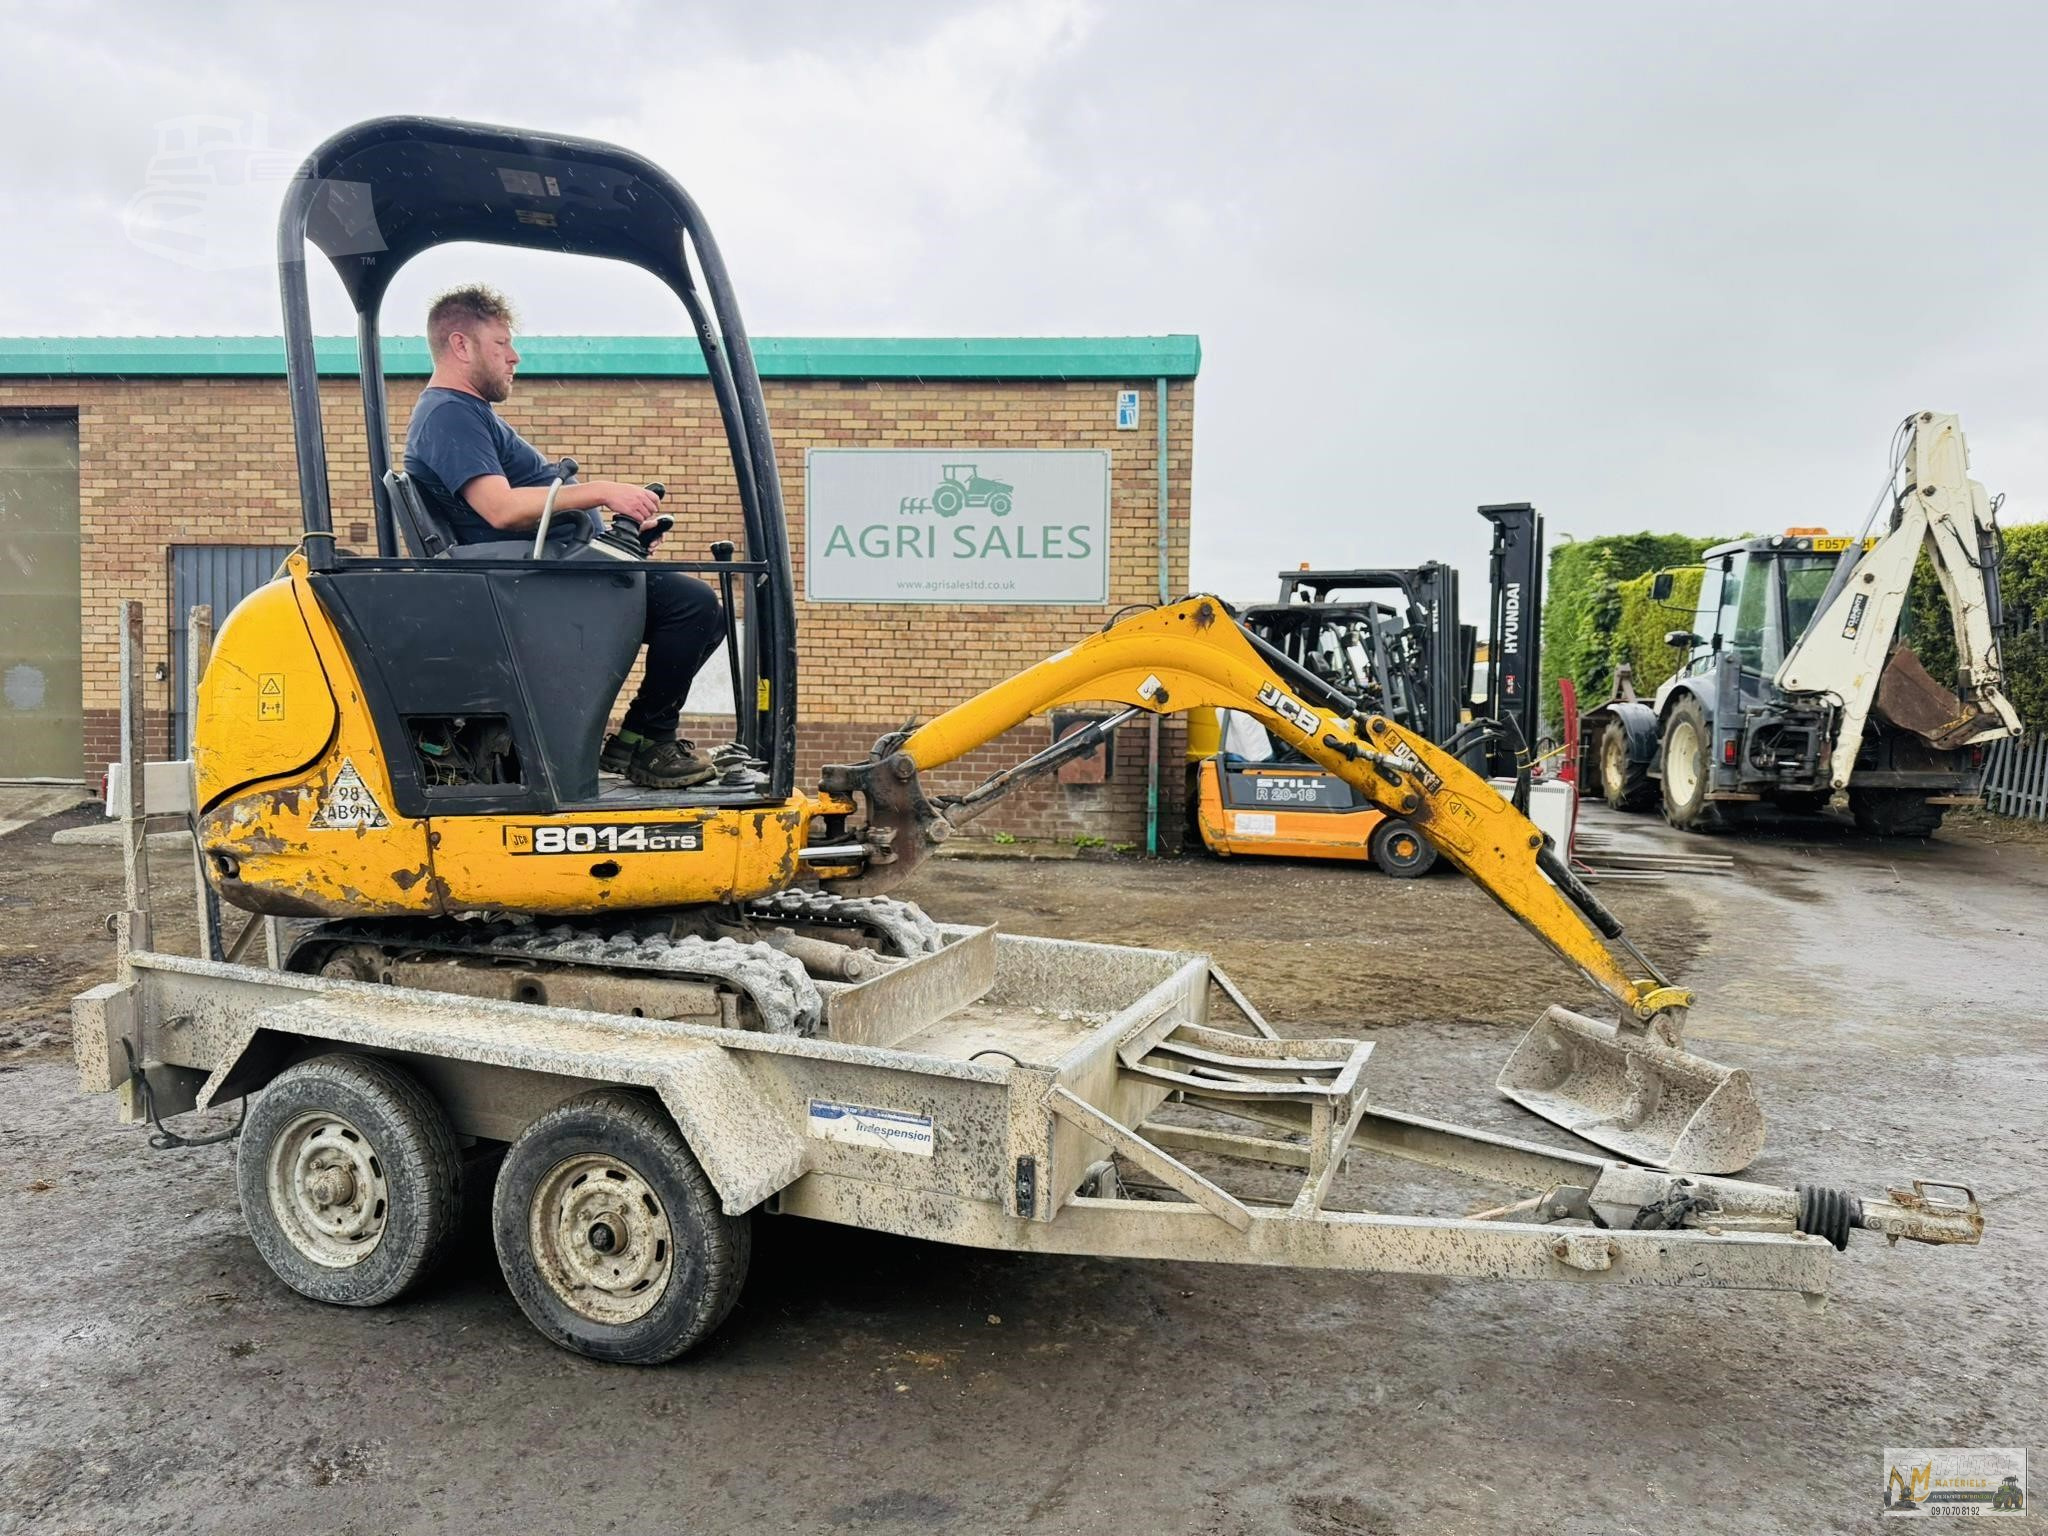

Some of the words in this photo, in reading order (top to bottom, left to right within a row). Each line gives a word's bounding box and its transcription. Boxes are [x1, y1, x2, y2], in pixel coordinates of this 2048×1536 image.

[823, 524, 936, 559] AGRI
[952, 524, 1092, 560] SALES
[896, 575, 1016, 592] www.agrisalesltd.co.uk
[1504, 583, 1520, 654] HYUNDAI
[1258, 687, 1321, 735] JCB
[1256, 778, 1326, 789] STILL
[338, 786, 360, 802] 98
[327, 804, 372, 820] AB9N
[855, 1120, 931, 1143] Indespension
